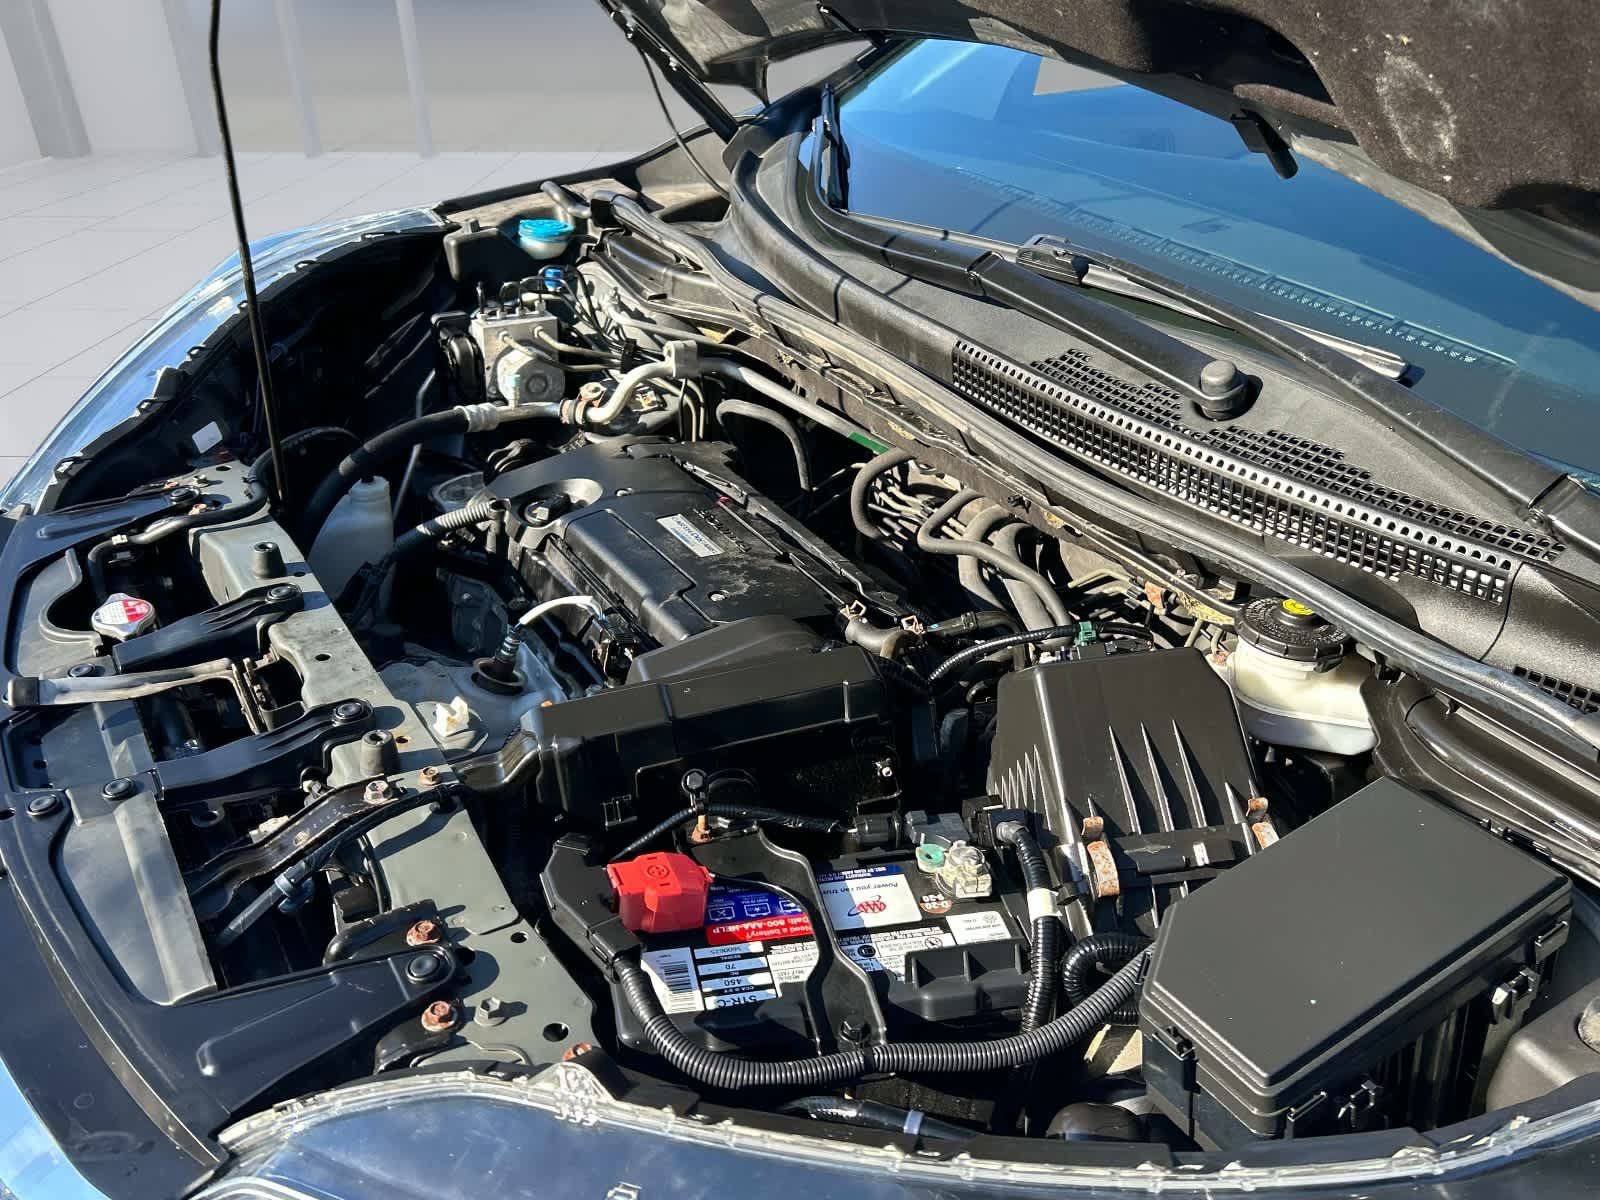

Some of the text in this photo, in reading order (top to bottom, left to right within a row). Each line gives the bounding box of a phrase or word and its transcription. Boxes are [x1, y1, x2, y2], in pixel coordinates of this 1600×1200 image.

[857, 900, 886, 913] AAA
[745, 928, 781, 938] battery?
[724, 979, 742, 987] 450
[716, 994, 758, 1008] 51R-C
